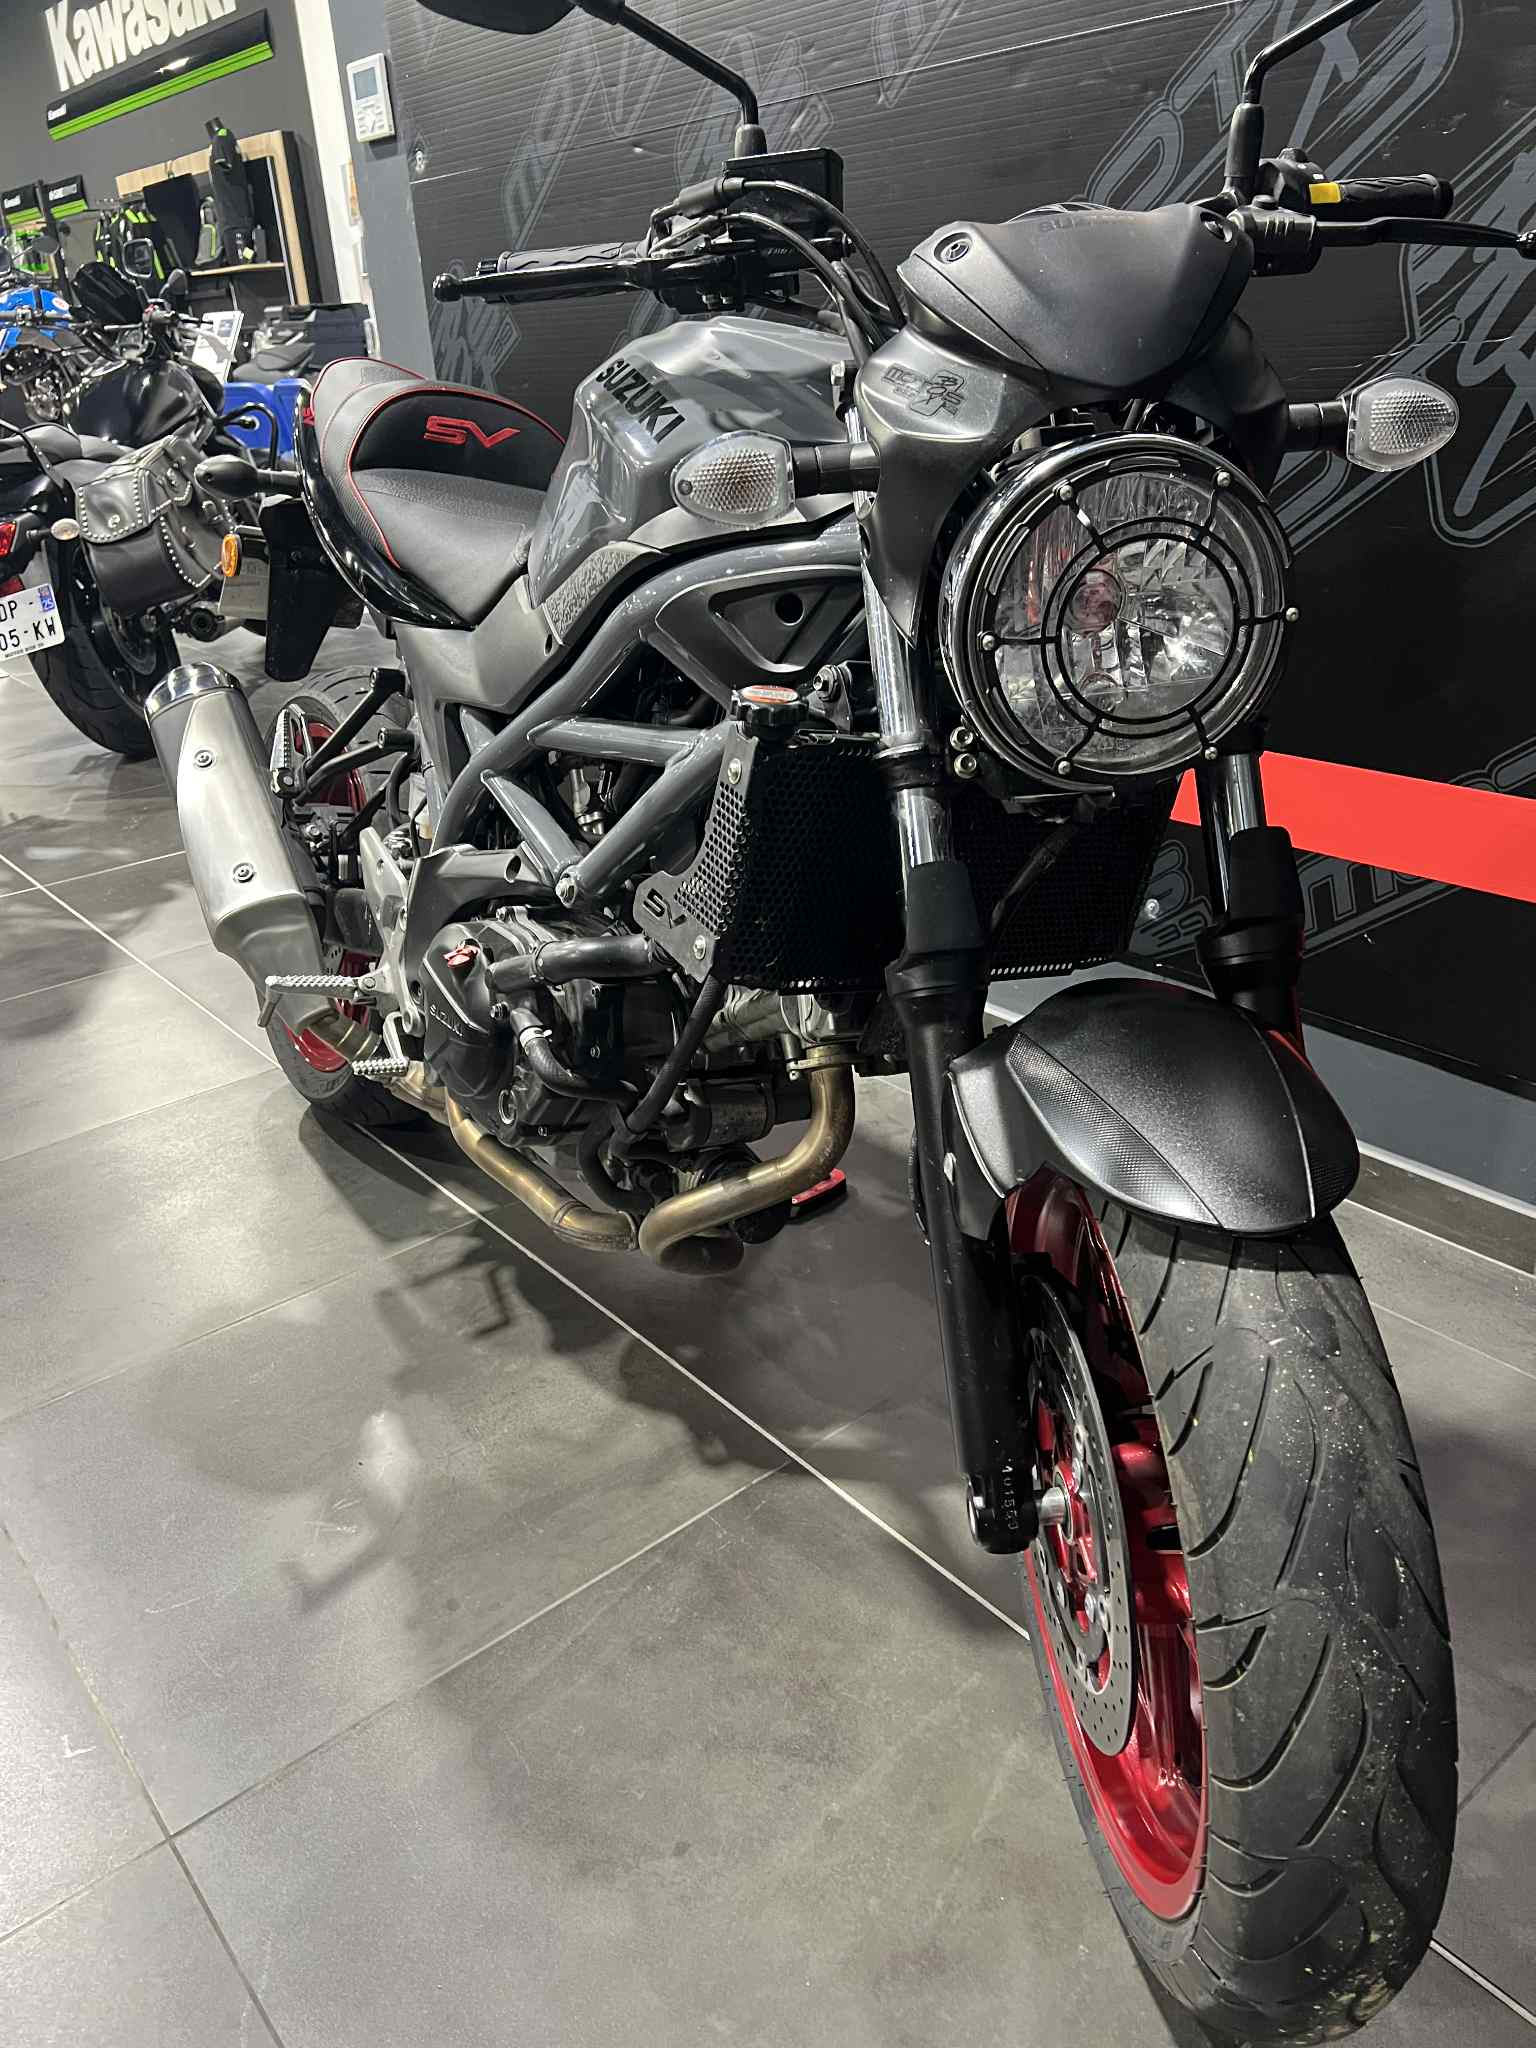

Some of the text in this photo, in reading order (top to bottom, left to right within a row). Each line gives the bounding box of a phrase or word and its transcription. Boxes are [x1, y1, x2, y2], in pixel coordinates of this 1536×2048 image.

[44, 0, 237, 92] Kawasa
[424, 415, 521, 448] SV
[596, 358, 686, 444] SUZUKI
[643, 888, 688, 929] SV
